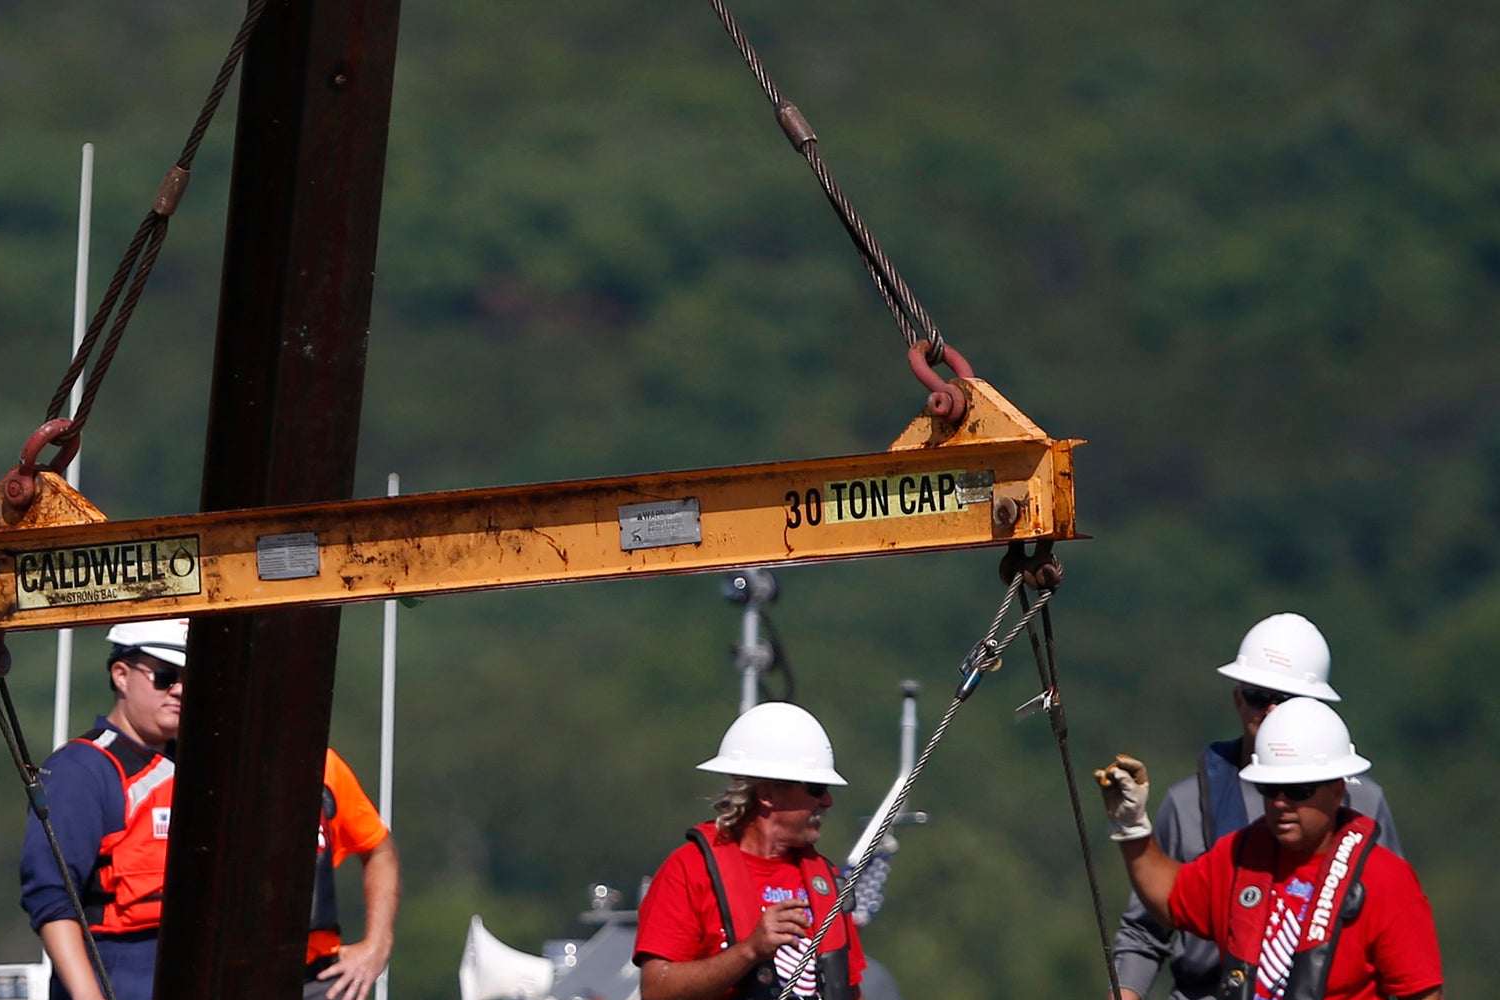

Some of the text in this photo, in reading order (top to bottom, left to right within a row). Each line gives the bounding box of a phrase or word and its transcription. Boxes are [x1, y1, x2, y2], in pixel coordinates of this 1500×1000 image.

[785, 487, 822, 529] 30
[830, 479, 890, 520] TON
[19, 543, 166, 593] CALDWELL
